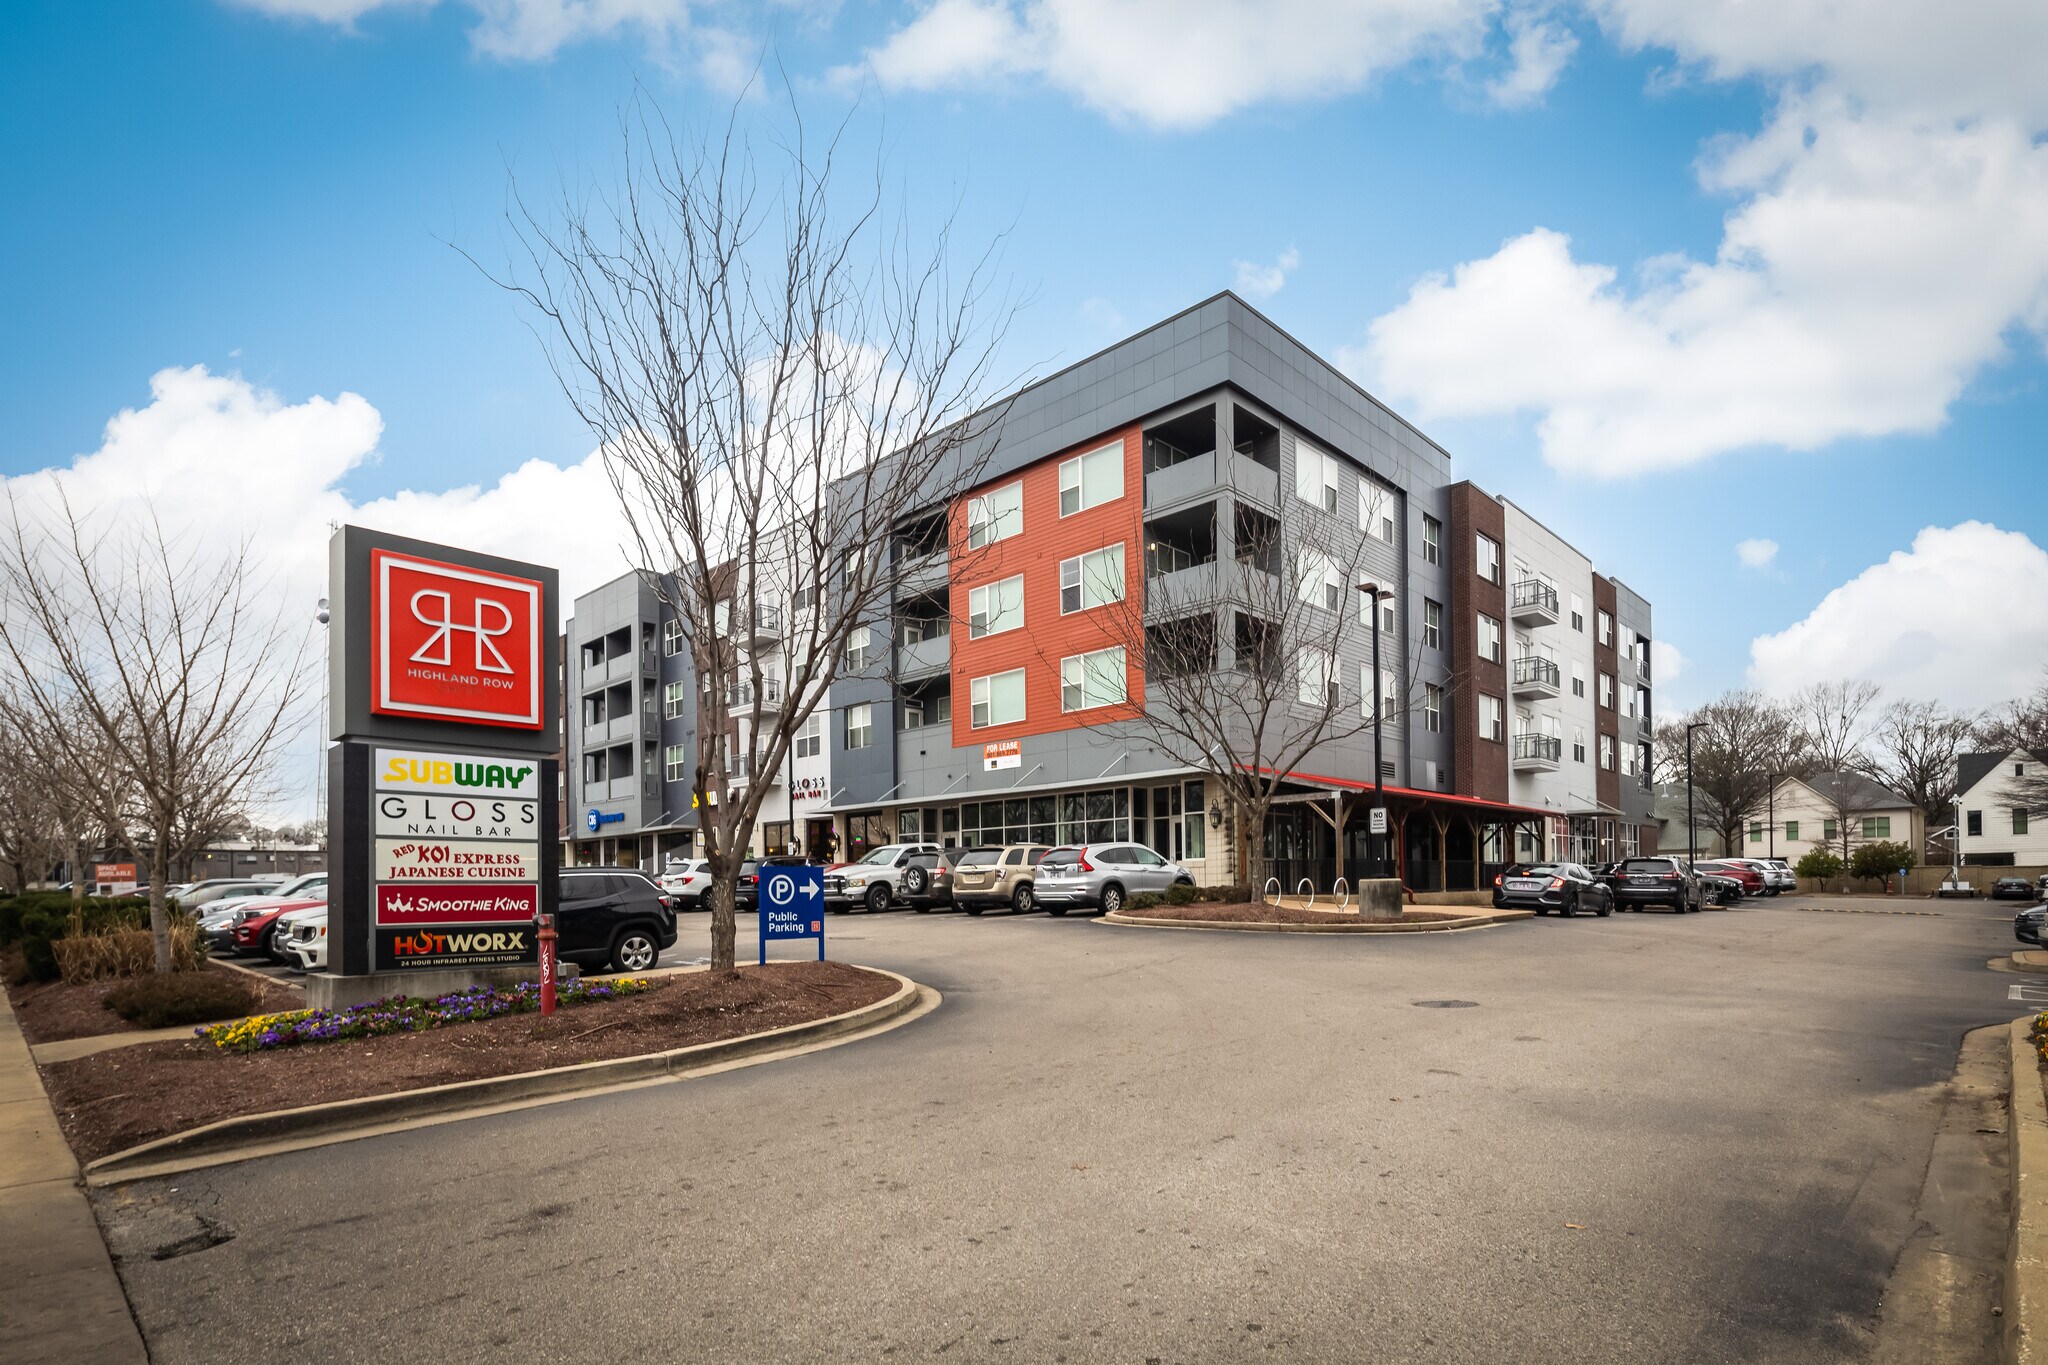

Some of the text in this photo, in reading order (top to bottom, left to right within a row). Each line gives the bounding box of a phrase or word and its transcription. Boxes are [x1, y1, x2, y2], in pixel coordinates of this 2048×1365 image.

[408, 668, 479, 685] HIGHLAND
[483, 677, 514, 690] ROW
[986, 740, 1018, 752] FOR LEASE
[383, 758, 533, 789] SUBWAY
[380, 797, 535, 824] GLOSS
[1373, 811, 1383, 819] NO
[407, 824, 511, 837] NAIL BAR
[392, 844, 520, 865] RED KOI EXPRESS
[389, 866, 526, 879] JAPANESE CUISINE
[415, 897, 493, 912] SMOOTHIE
[768, 911, 798, 922] Public
[768, 922, 805, 934] Parking
[433, 957, 468, 965] INFRARED
[496, 954, 520, 962] STUDIO
